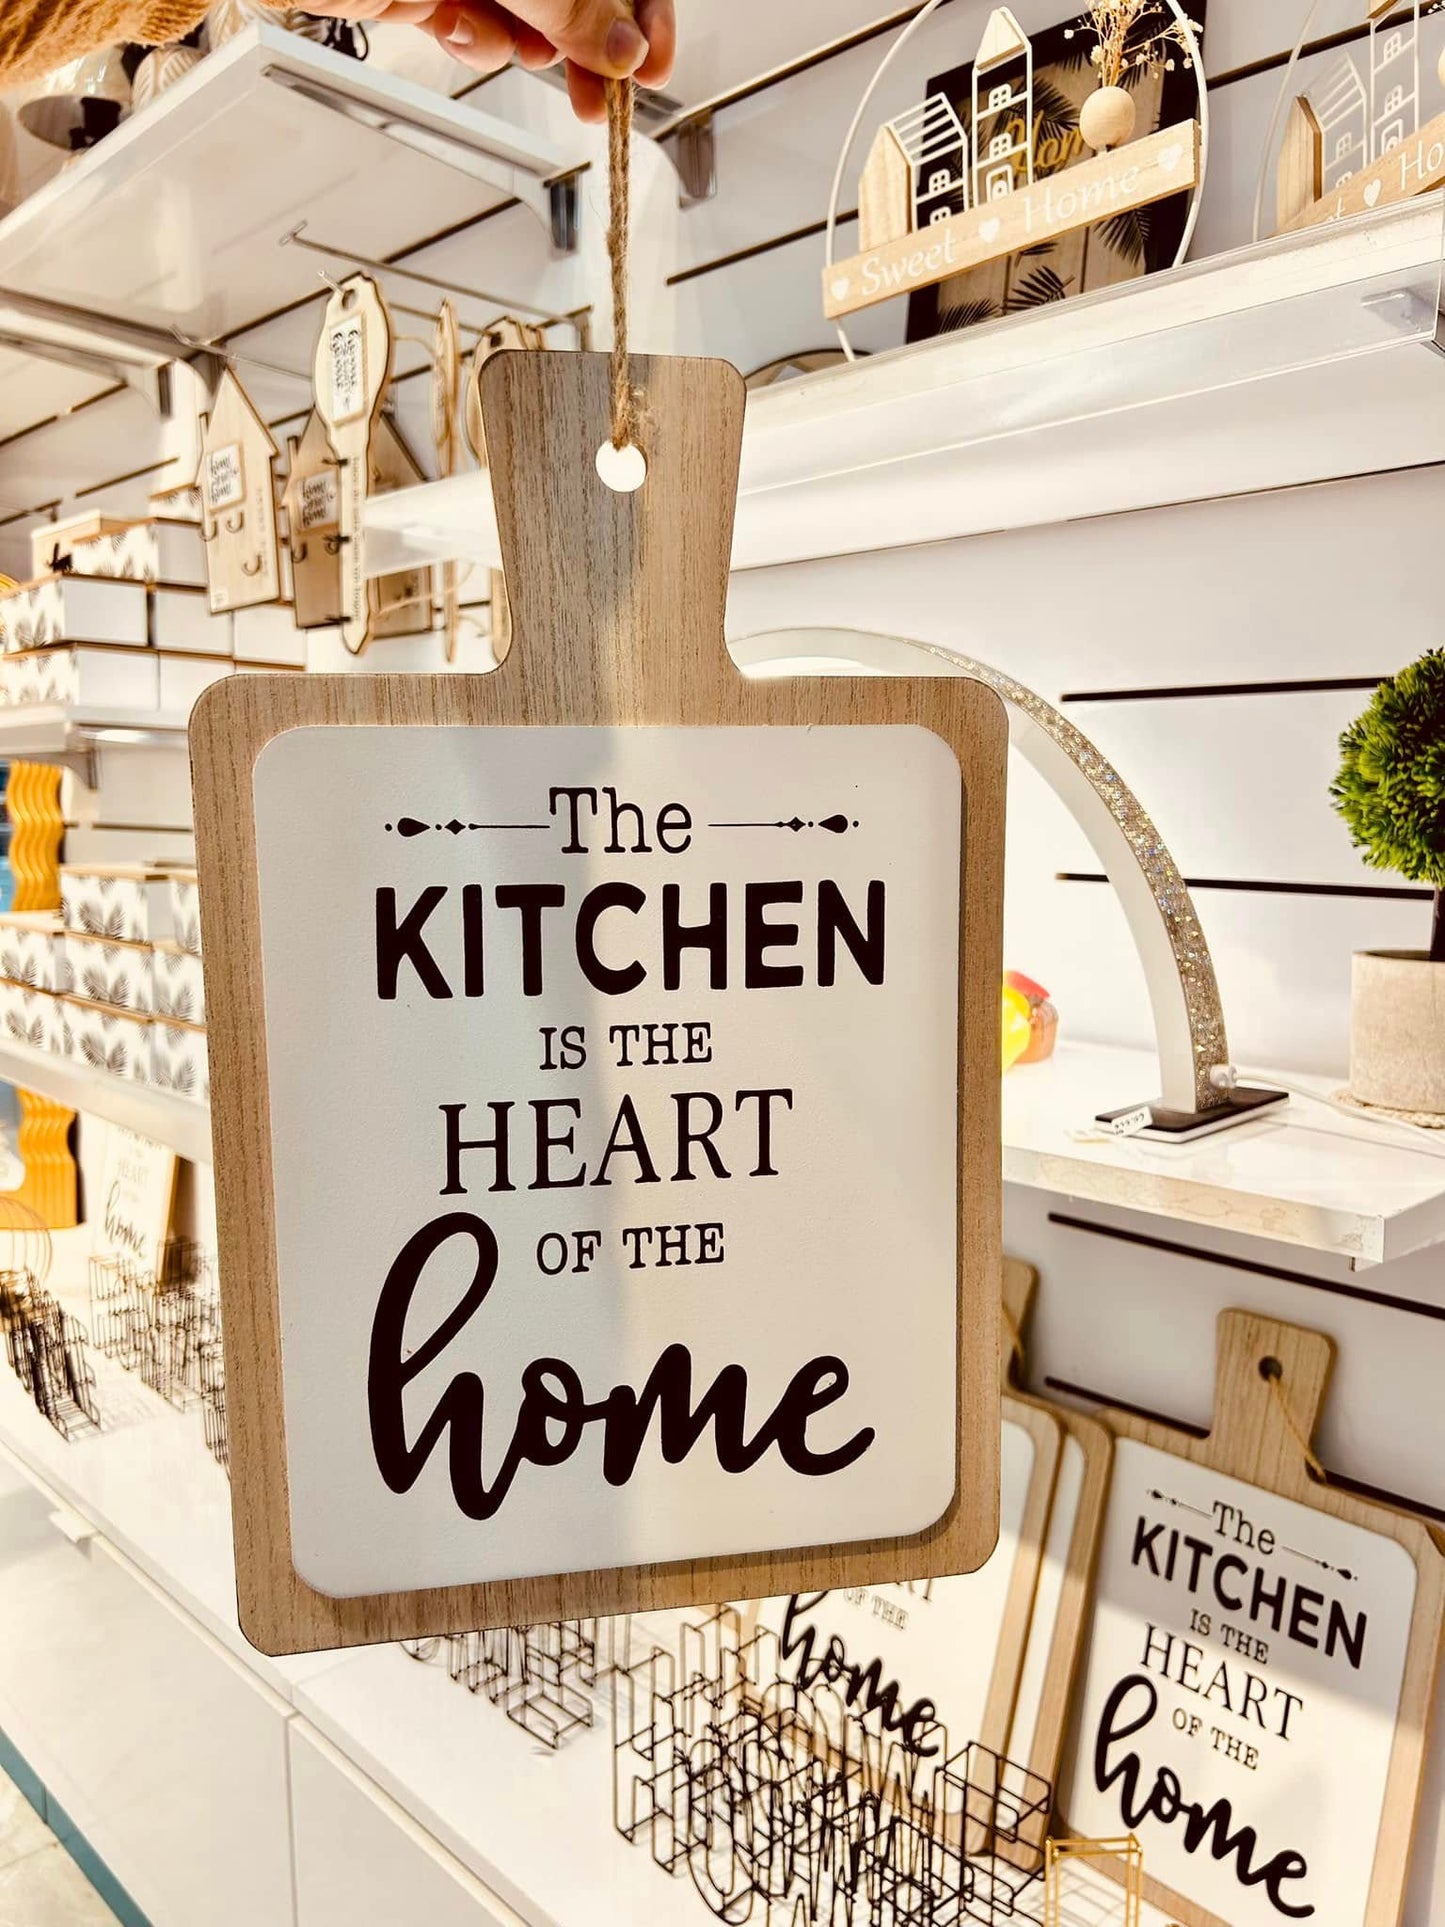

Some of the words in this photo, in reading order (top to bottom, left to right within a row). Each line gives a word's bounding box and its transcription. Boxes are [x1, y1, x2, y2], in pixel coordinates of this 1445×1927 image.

[860, 229, 956, 297] Sweet
[1022, 165, 1141, 235] Home
[548, 786, 693, 854] The
[375, 879, 886, 1001] KITCHEN
[538, 1025, 588, 1071] IS
[608, 1021, 713, 1068] THE
[438, 1087, 794, 1196] HEART
[536, 1230, 602, 1276] OF
[622, 1222, 725, 1270] THE
[368, 1211, 876, 1521] home
[1212, 1500, 1276, 1555] The
[870, 1594, 909, 1631] THE
[1131, 1514, 1367, 1670] KITCHEN
[1189, 1607, 1212, 1636] IS
[1220, 1622, 1269, 1666] THE
[776, 1590, 939, 1757] home
[1140, 1620, 1303, 1741] HEART
[1171, 1706, 1203, 1738] OF
[1210, 1725, 1260, 1771] THE
[1094, 1673, 1316, 1919] home
